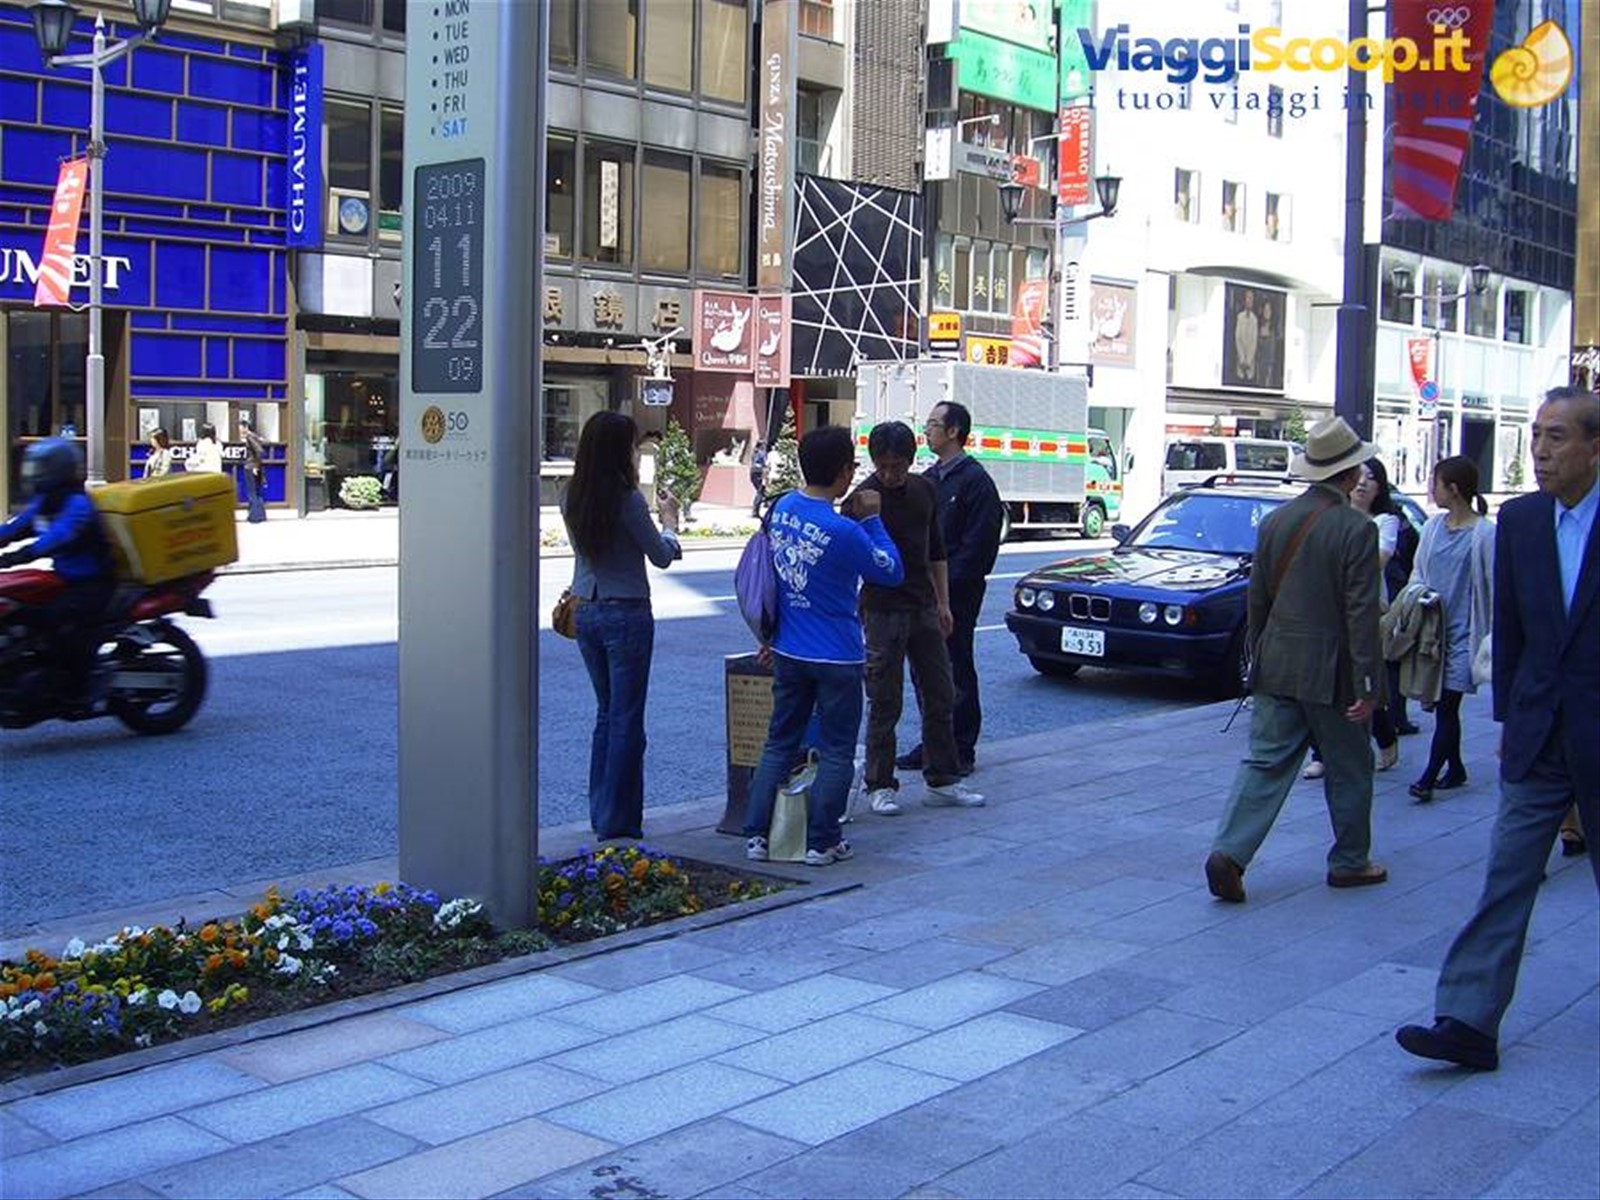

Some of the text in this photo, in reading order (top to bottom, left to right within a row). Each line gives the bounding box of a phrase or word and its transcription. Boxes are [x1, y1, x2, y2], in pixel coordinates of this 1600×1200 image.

[444, 0, 469, 17] MON
[444, 21, 469, 41] TUE
[444, 45, 469, 65] WED
[444, 70, 468, 89] THU
[443, 93, 466, 113] FRI
[442, 118, 467, 138] SAT
[292, 60, 308, 234] CHAUMET
[763, 53, 784, 243] GINZA Matsushima
[427, 172, 477, 200] 2009
[428, 234, 470, 288] 11
[423, 294, 478, 349] 22
[169, 445, 247, 459] CHMET
